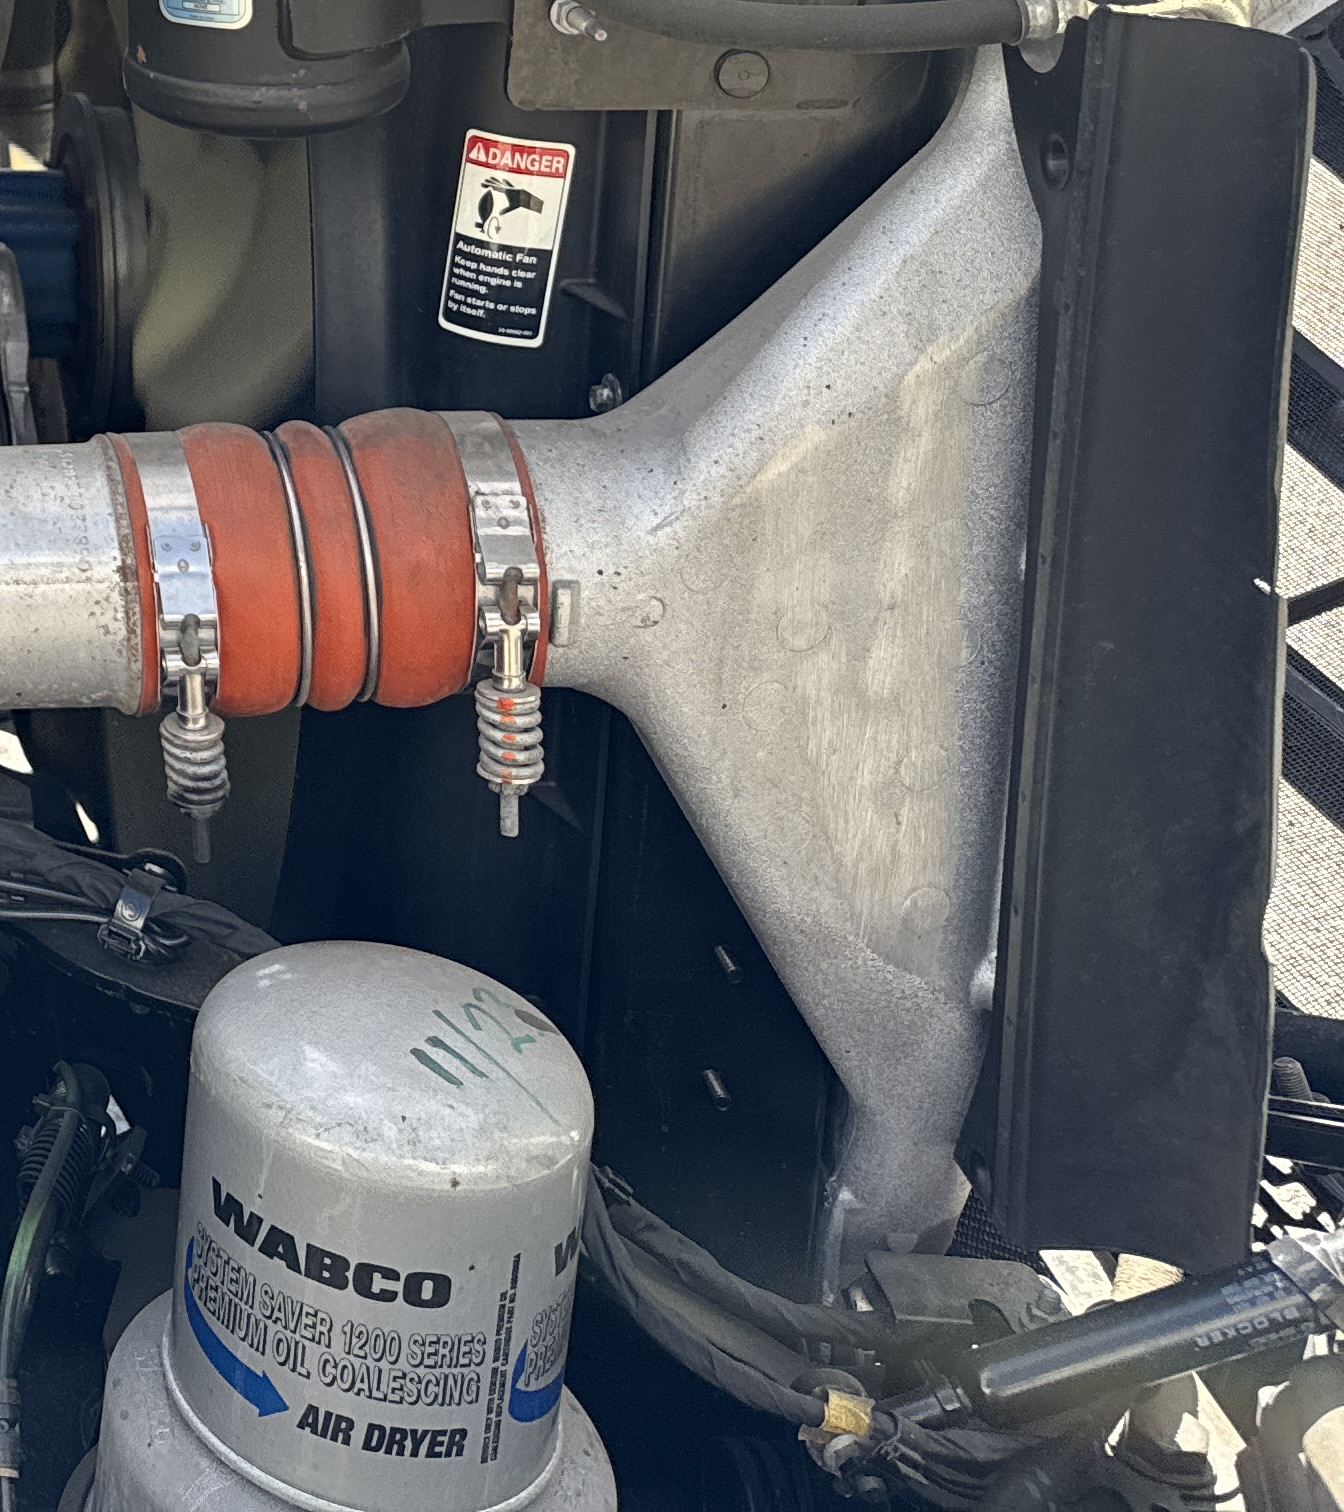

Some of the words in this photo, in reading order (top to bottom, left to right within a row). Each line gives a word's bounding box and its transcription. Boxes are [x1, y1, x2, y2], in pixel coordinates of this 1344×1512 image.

[488, 147, 565, 174] DANGER
[456, 240, 513, 262] Automatic
[515, 253, 537, 264] Fan
[452, 267, 477, 280] when
[478, 274, 512, 287] engine
[513, 279, 523, 288] is
[454, 255, 478, 269] Keep
[479, 262, 509, 276] hands
[511, 269, 536, 279] clear
[451, 276, 489, 295] running.
[447, 299, 459, 312] by
[459, 304, 486, 318] itself.
[449, 289, 465, 301] Fan
[466, 296, 495, 310] starts
[496, 303, 508, 312] or
[509, 305, 537, 315] stops
[212, 1175, 453, 1309] WABCO
[194, 1221, 257, 1312] SYSTEM
[260, 1284, 333, 1348] SAVER
[341, 1319, 401, 1364] 1200
[406, 1331, 487, 1370] SERIES
[189, 1264, 268, 1357] PREMIUM
[271, 1332, 312, 1381] OIL
[316, 1353, 482, 1408] COALESCING
[296, 1403, 355, 1447] AIR
[360, 1424, 470, 1460] DRYER
